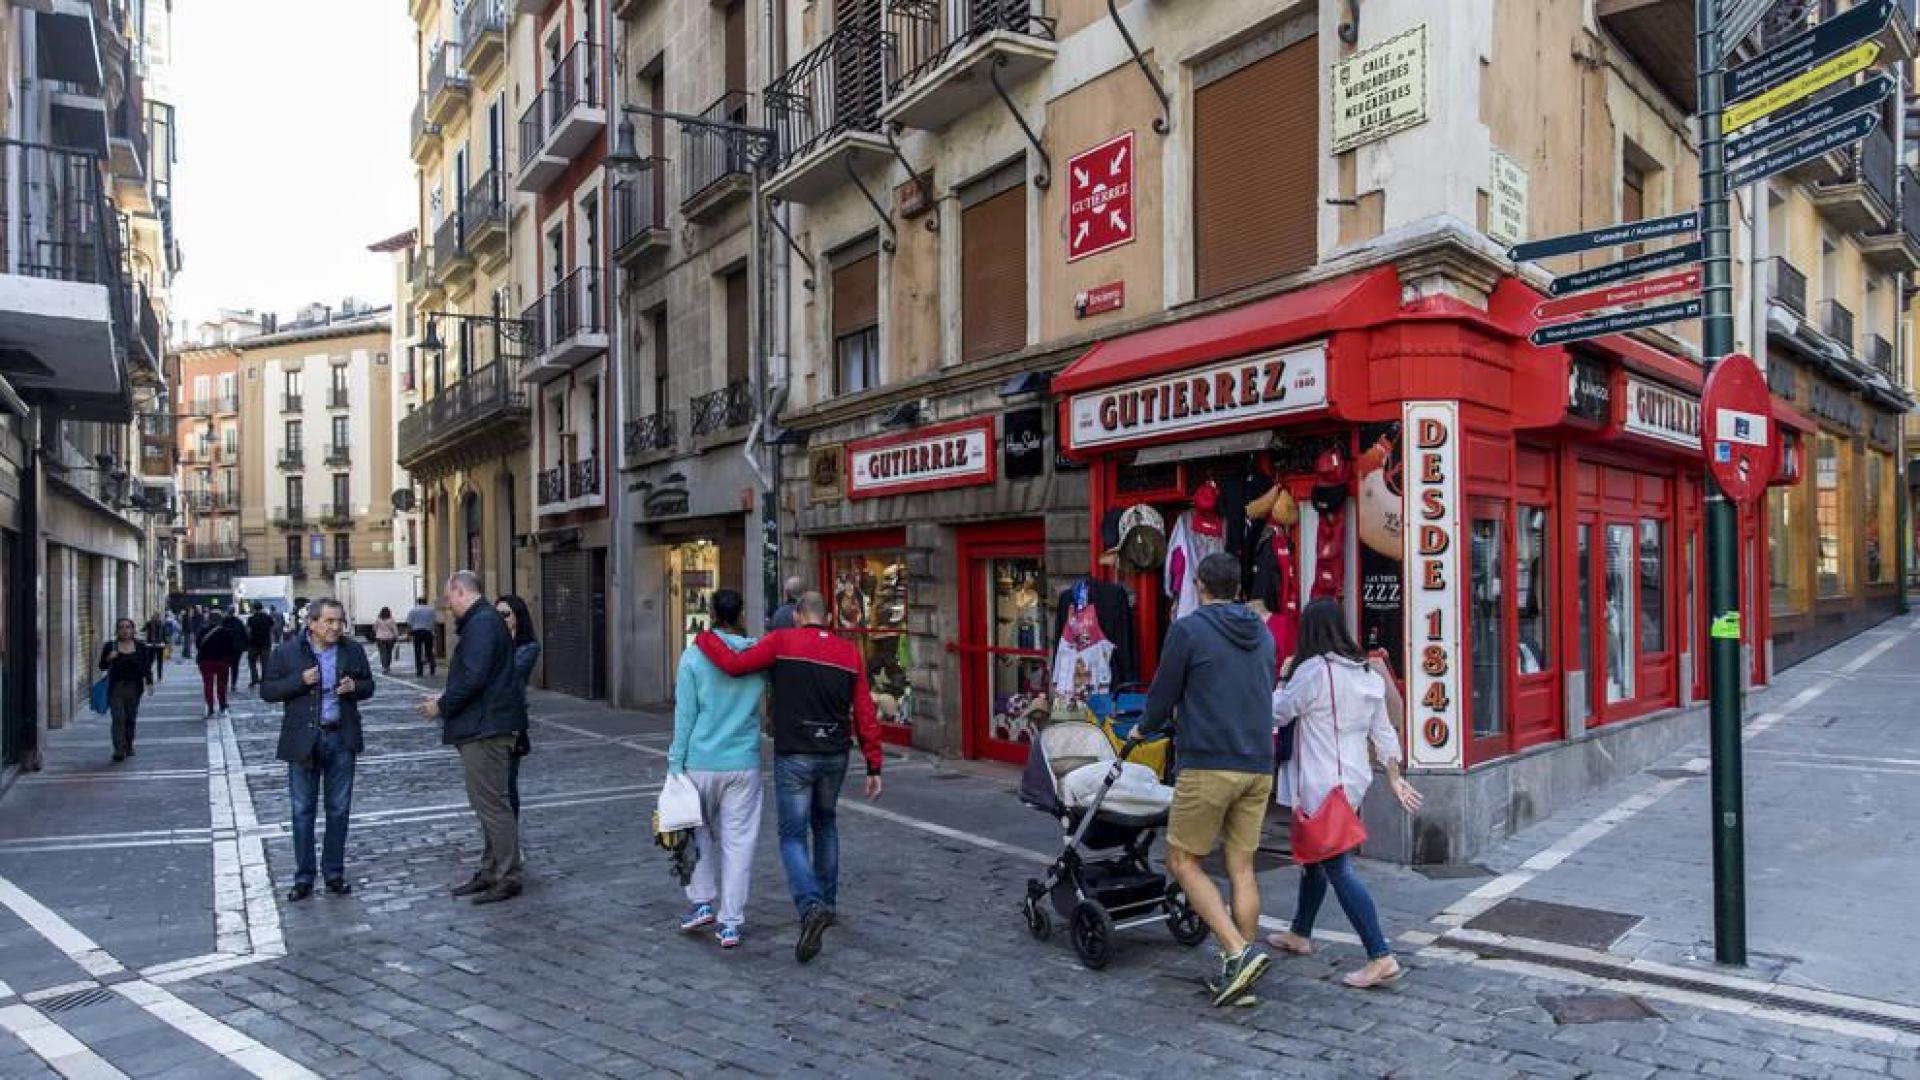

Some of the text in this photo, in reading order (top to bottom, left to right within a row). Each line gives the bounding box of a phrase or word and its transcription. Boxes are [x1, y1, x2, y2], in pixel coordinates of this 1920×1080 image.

[1345, 62, 1409, 99] MERCADERES
[1363, 52, 1391, 75] CALLE
[1345, 83, 1411, 119] MERCADERES
[1360, 106, 1391, 128] KALEA
[1072, 181, 1128, 214] GUTIERREZ
[1100, 359, 1286, 431] GUTIERREZ
[1636, 385, 1700, 438] GUTIERRE
[868, 437, 969, 479] GUTIERREZ
[1365, 583, 1400, 601] ZZZ
[1417, 418, 1450, 748] DESDE 1840
